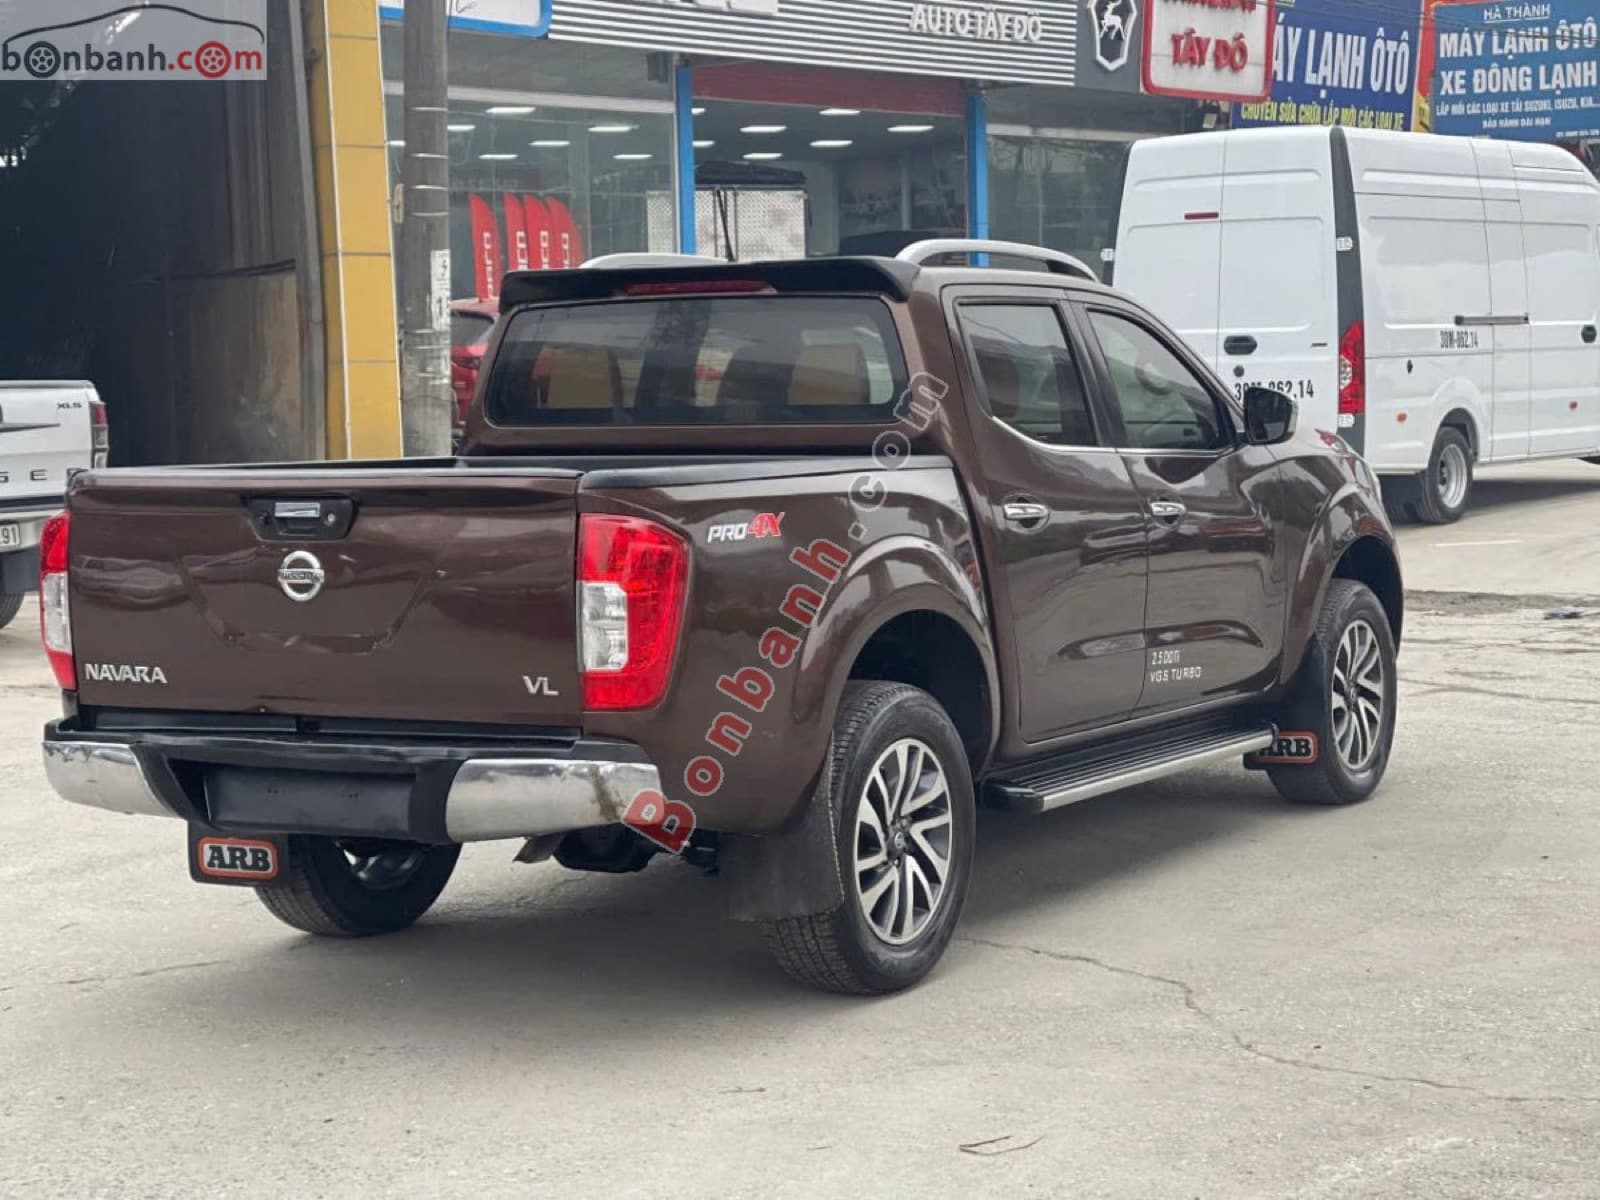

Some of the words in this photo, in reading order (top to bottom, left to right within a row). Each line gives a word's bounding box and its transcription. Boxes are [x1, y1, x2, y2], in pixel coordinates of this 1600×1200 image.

[909, 4, 971, 35] AUTO
[1483, 4, 1502, 20] HÀ
[1505, 3, 1550, 19] THÀNH
[1171, 27, 1210, 67] TÂY
[1439, 27, 1485, 58] MÁY
[1492, 26, 1549, 60] LẠNH
[1555, 15, 1598, 51] ÔTÔ
[1272, 12, 1302, 83] ÁY
[1304, 28, 1367, 99] LẠNH
[1370, 26, 1410, 95] ÔTÔ
[1440, 69, 1467, 96] XE
[1473, 62, 1533, 94] ĐÔNG
[1539, 60, 1598, 95] LẠNH
[56, 402, 82, 410] XLS
[84, 663, 168, 684] NAVARA
[522, 675, 559, 696] VL
[1150, 669, 1169, 683] VGS
[1171, 666, 1202, 680] TURBO
[1266, 738, 1312, 757] RB
[207, 844, 271, 872] ARB
